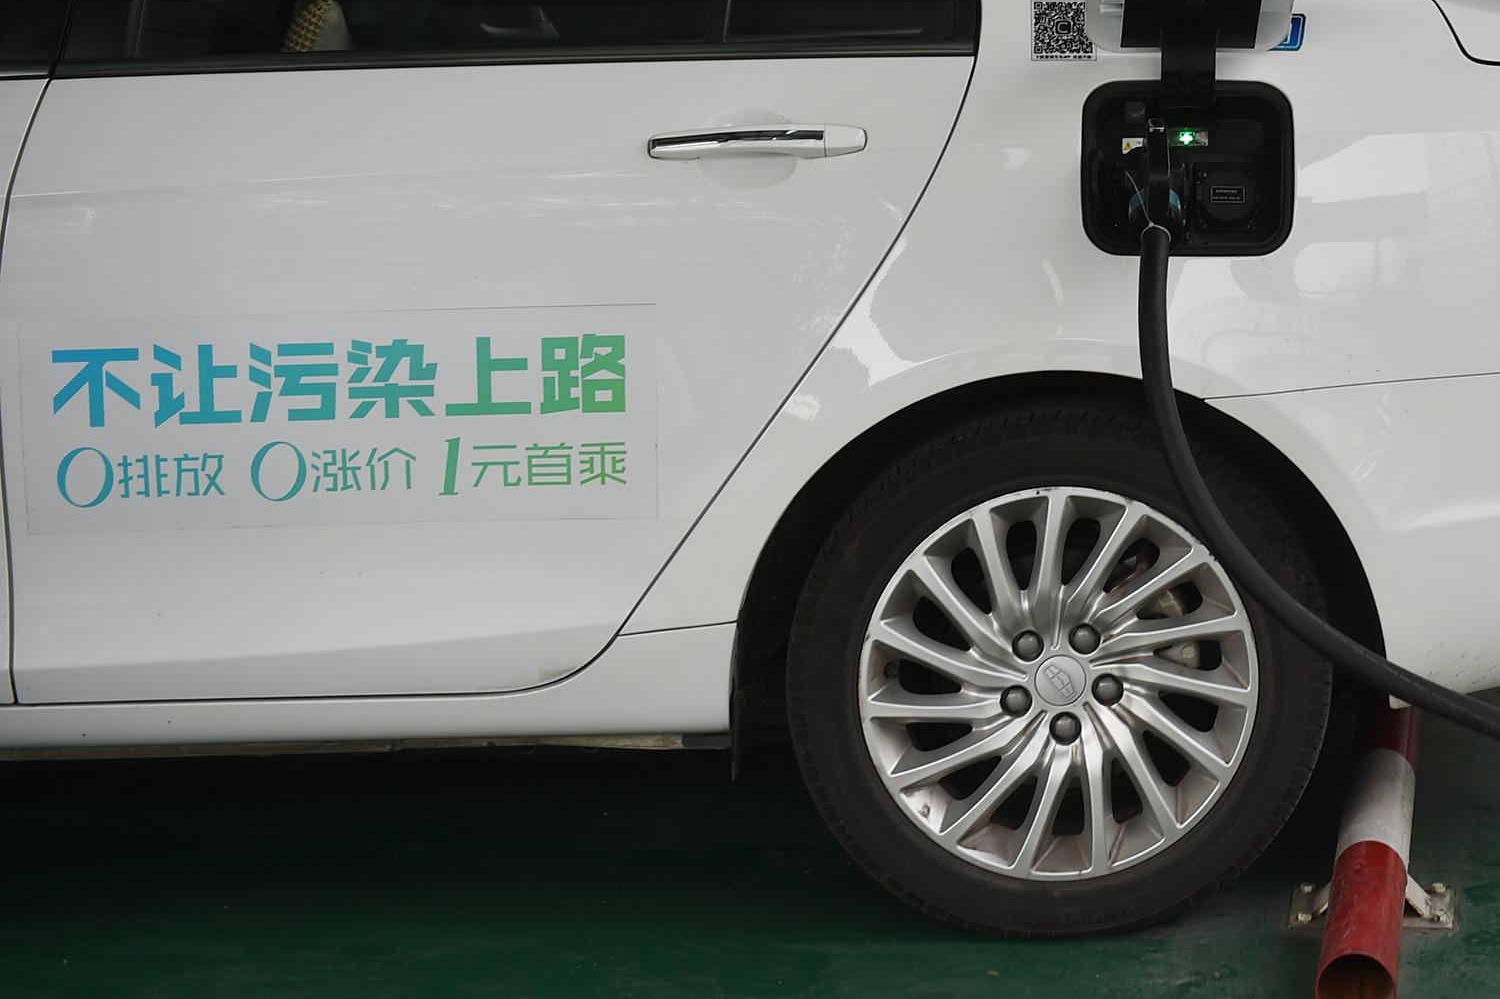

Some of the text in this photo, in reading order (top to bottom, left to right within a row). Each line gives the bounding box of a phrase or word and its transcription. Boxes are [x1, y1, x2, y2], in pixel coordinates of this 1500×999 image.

[51, 333, 627, 428] 不让污染上路
